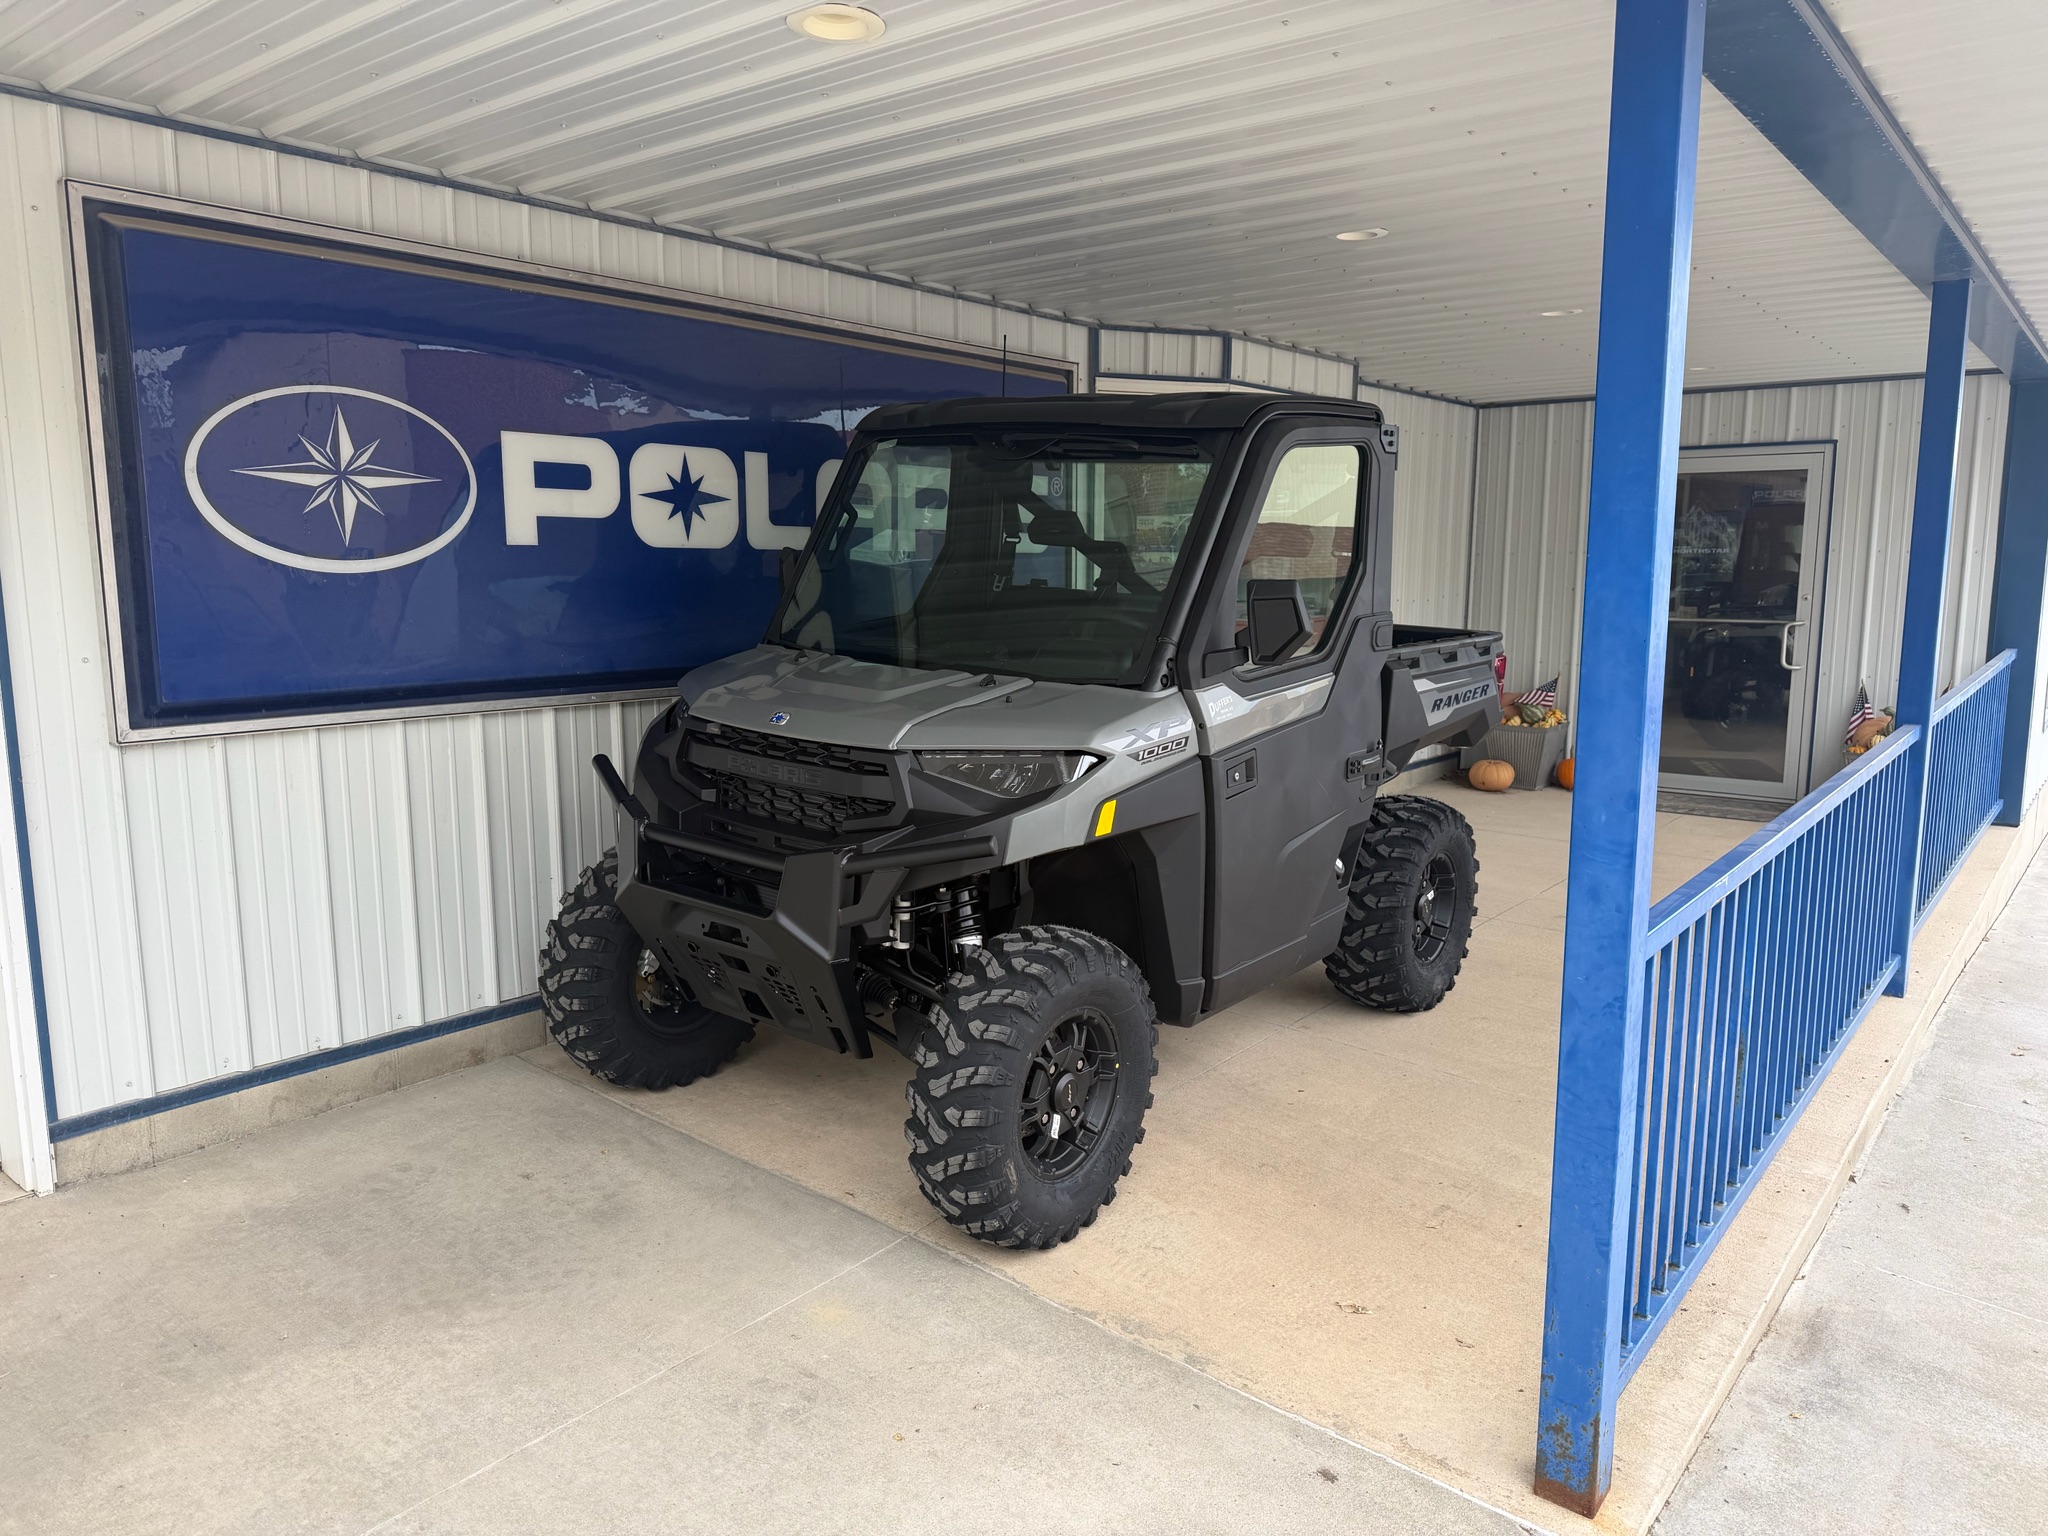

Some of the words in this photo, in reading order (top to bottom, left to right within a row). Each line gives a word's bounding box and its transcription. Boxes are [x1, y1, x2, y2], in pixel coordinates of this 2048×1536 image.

[501, 430, 1049, 554] POLAR
[1430, 683, 1490, 713] RANGER
[1121, 715, 1191, 751] XP
[1138, 738, 1186, 760] 1000
[727, 753, 824, 787] POLARIS
